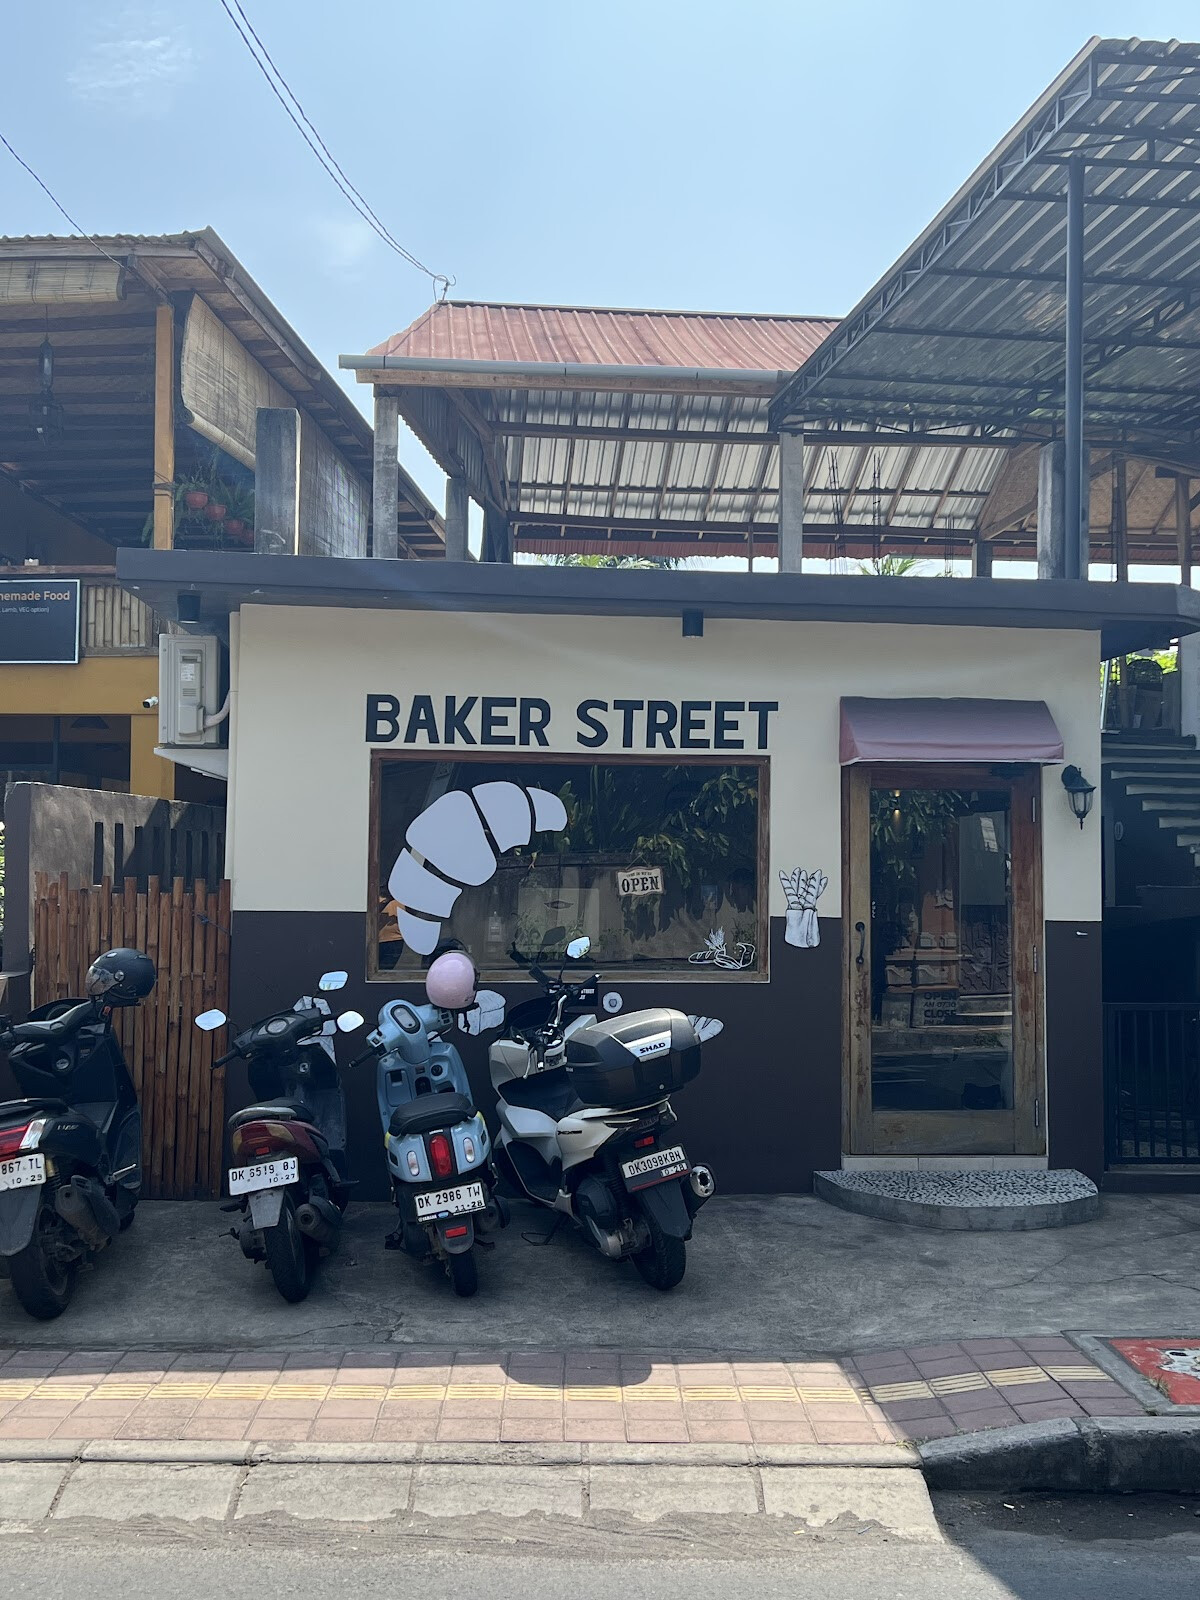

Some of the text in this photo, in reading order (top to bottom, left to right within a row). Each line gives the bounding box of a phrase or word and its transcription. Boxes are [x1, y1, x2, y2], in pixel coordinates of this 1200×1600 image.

[43, 590, 70, 600] Food
[365, 693, 779, 750] BAKER STREET
[621, 876, 660, 893] OPEN
[923, 991, 957, 1000] OPEN
[639, 1042, 666, 1054] SHAD
[1, 1157, 42, 1175] 867 TL
[231, 1169, 245, 1182] DK
[417, 1185, 480, 1209] DK 2986 TW
